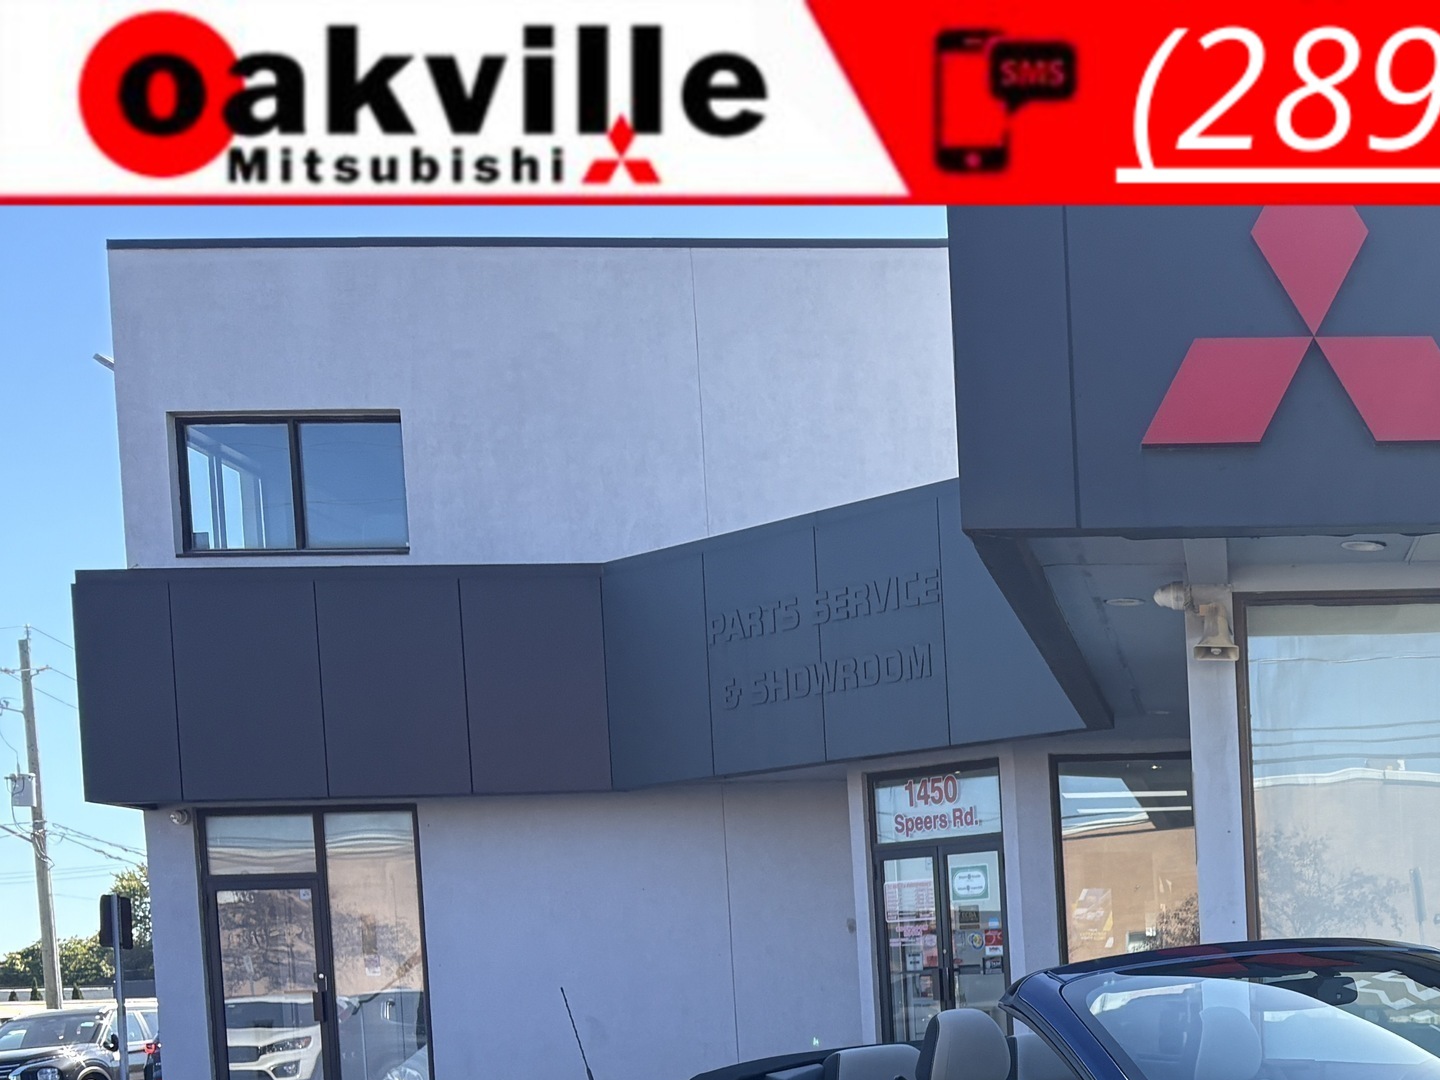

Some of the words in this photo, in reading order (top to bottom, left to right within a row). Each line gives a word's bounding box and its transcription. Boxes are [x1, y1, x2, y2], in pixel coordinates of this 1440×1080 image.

[709, 597, 801, 646] PARTS
[813, 568, 940, 626] SERVICE
[751, 643, 933, 706] SHOWROOM
[904, 774, 958, 807] 1450
[894, 813, 948, 837] Speers
[952, 806, 979, 828] Rd.
